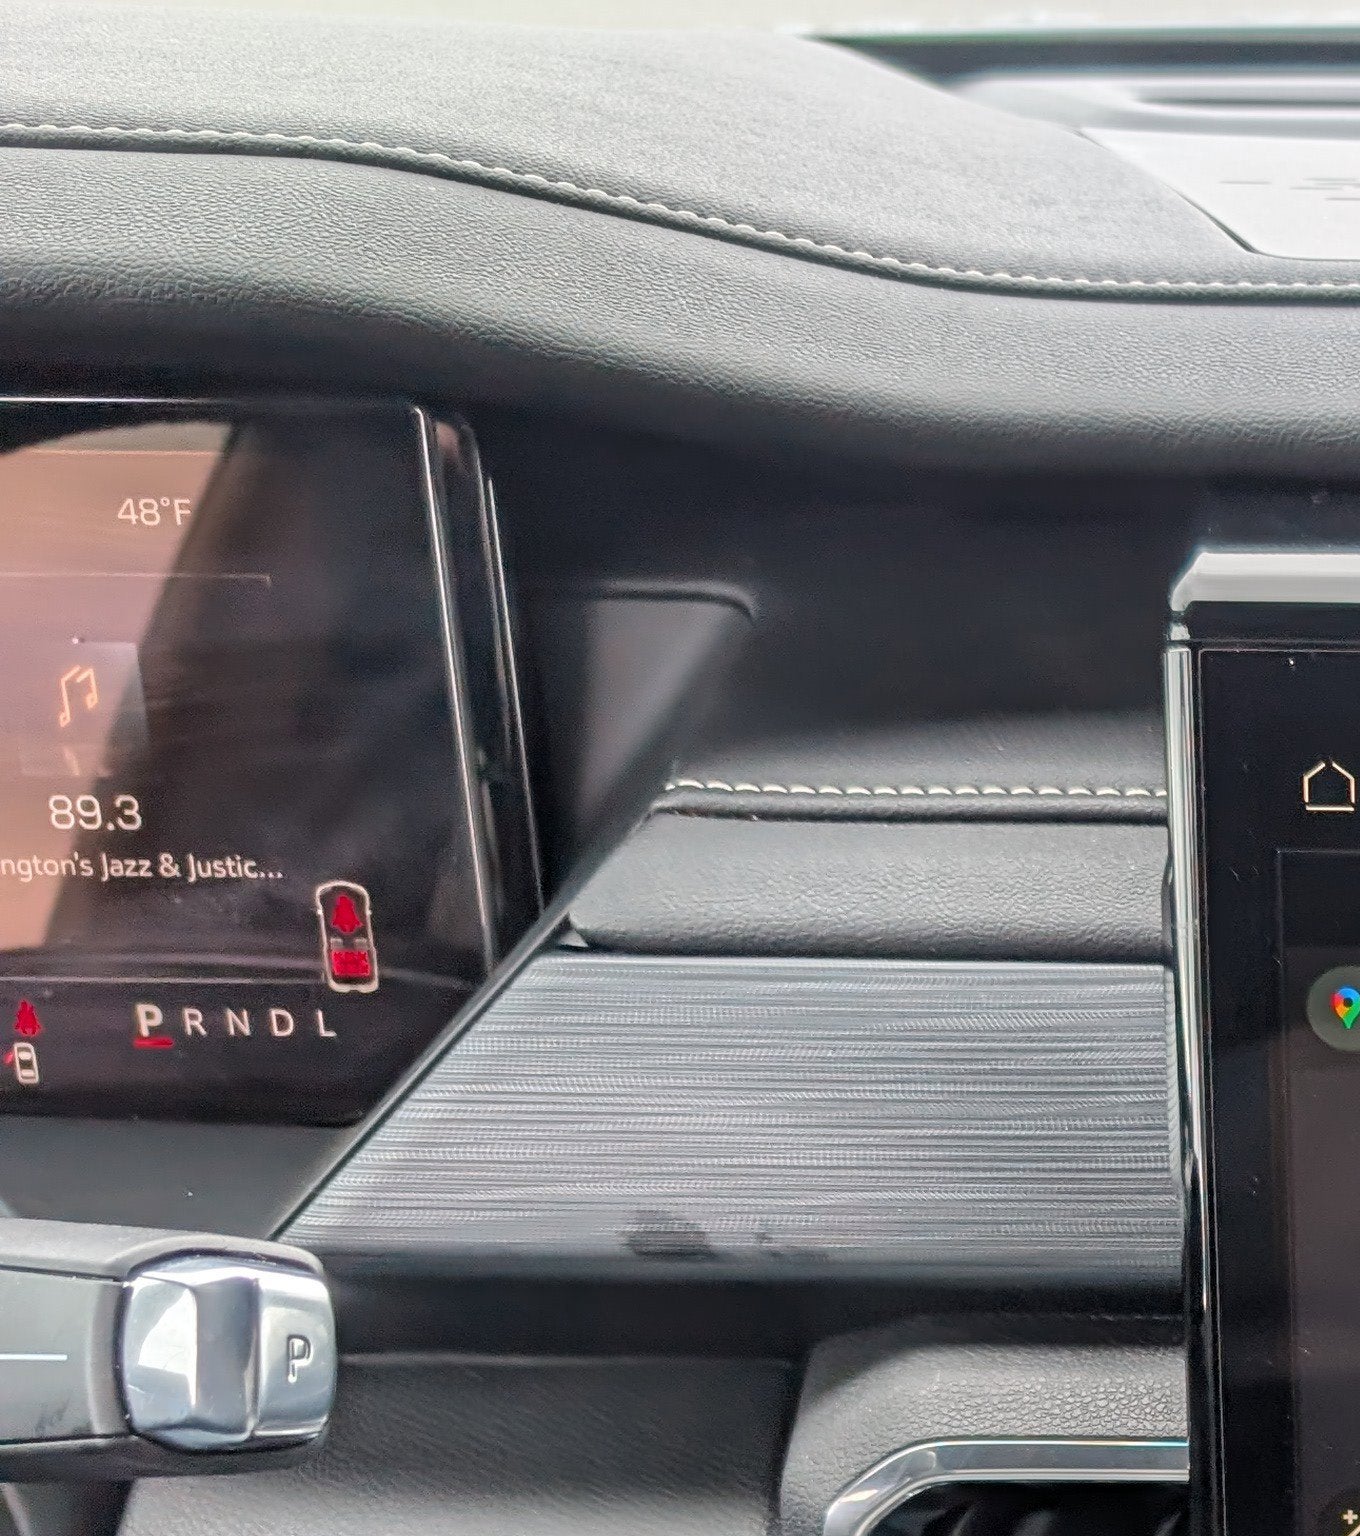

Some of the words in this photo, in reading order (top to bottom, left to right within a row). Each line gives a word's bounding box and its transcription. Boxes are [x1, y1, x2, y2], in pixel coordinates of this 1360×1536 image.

[116, 496, 191, 527] 48°F
[47, 796, 142, 832] 89.3
[100, 852, 153, 882] Jazz
[158, 852, 181, 878] &
[188, 853, 283, 883] Justic...
[135, 1003, 164, 1036] P
[182, 1007, 207, 1036] R
[225, 1008, 251, 1036] N
[269, 1008, 295, 1037] D
[316, 1009, 337, 1038] L
[286, 1333, 313, 1384] P
